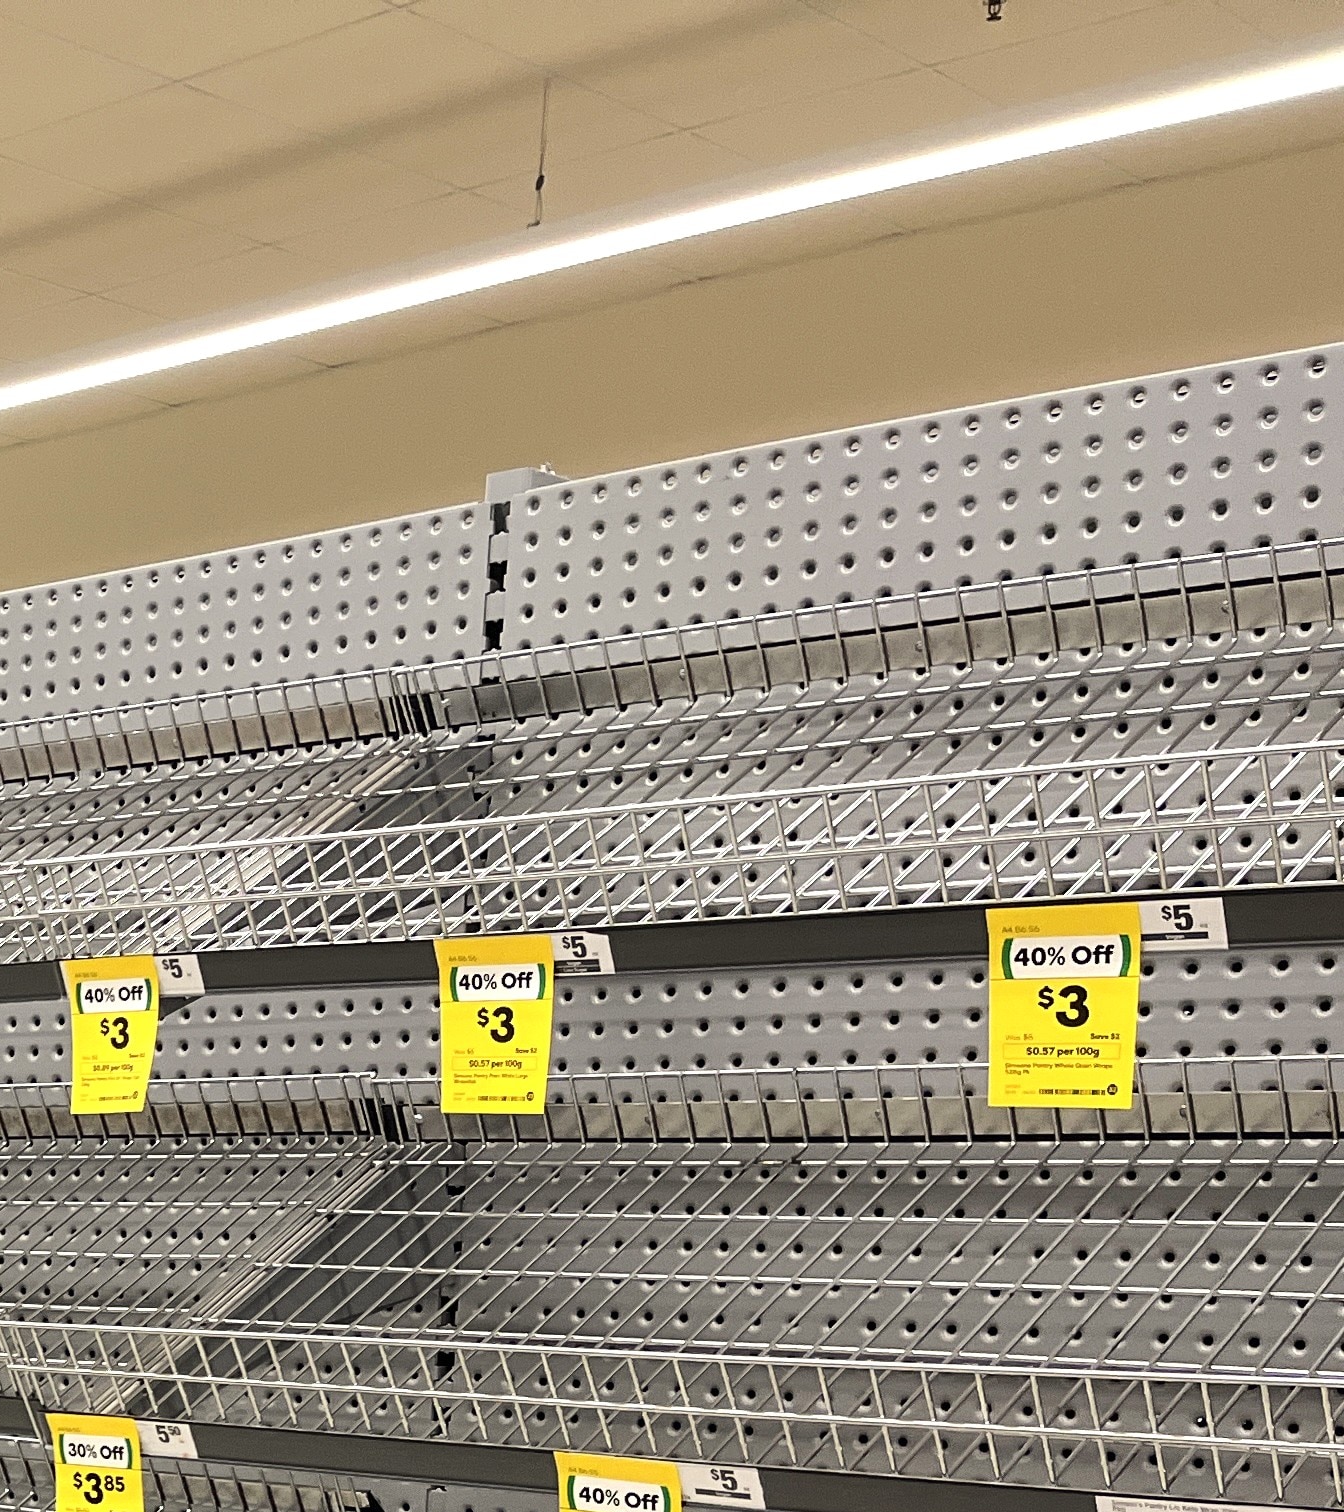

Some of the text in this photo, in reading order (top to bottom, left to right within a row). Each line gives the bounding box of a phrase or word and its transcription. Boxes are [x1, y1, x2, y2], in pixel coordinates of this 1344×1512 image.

[1161, 904, 1194, 931] $5
[562, 935, 587, 959] $5
[1013, 944, 1115, 967] 40% Off
[162, 958, 183, 979] $5
[459, 971, 534, 991] 40% Off
[84, 985, 144, 1003] 40% Off
[1037, 984, 1090, 1028] $3
[100, 1016, 130, 1050] $3
[477, 1005, 515, 1044] $3
[1057, 1048, 1074, 1058] per
[1075, 1046, 1100, 1059] 100g
[491, 1060, 503, 1069] per
[68, 1442, 125, 1461] 30% Off
[710, 1467, 738, 1491] $5
[578, 1486, 660, 1511] 40% Off
